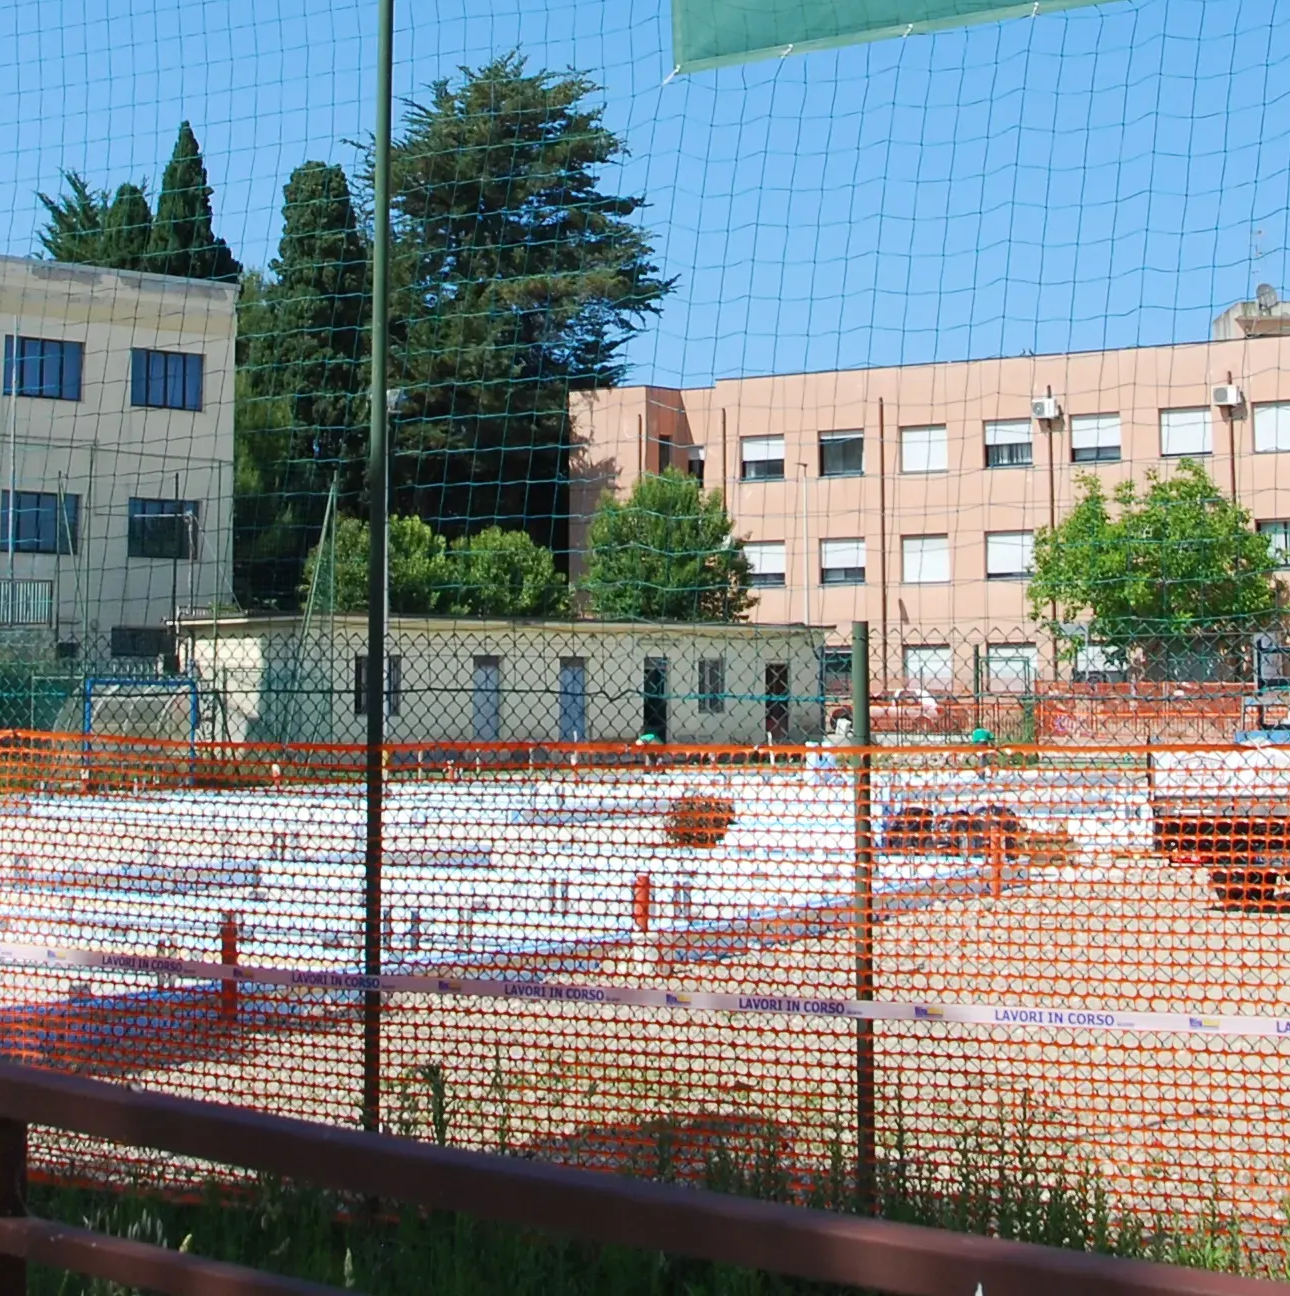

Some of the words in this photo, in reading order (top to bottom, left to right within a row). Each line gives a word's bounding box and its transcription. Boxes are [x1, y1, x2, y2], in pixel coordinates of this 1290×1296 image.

[102, 955, 135, 968] LAVORI
[137, 958, 149, 969] IN
[151, 960, 183, 973] CORSO
[292, 972, 326, 985] LAVORI
[330, 975, 342, 987] IN
[344, 976, 380, 989] CORSO
[504, 983, 547, 998] LAVORI
[549, 986, 562, 999] IN
[566, 987, 605, 1001] CORSO
[738, 997, 784, 1012] LAVORI
[787, 1000, 800, 1013] IN
[803, 1001, 845, 1015] CORSO
[995, 1009, 1044, 1023] LAVORI
[1048, 1011, 1063, 1024] IN
[1068, 1012, 1115, 1026] CORSO
